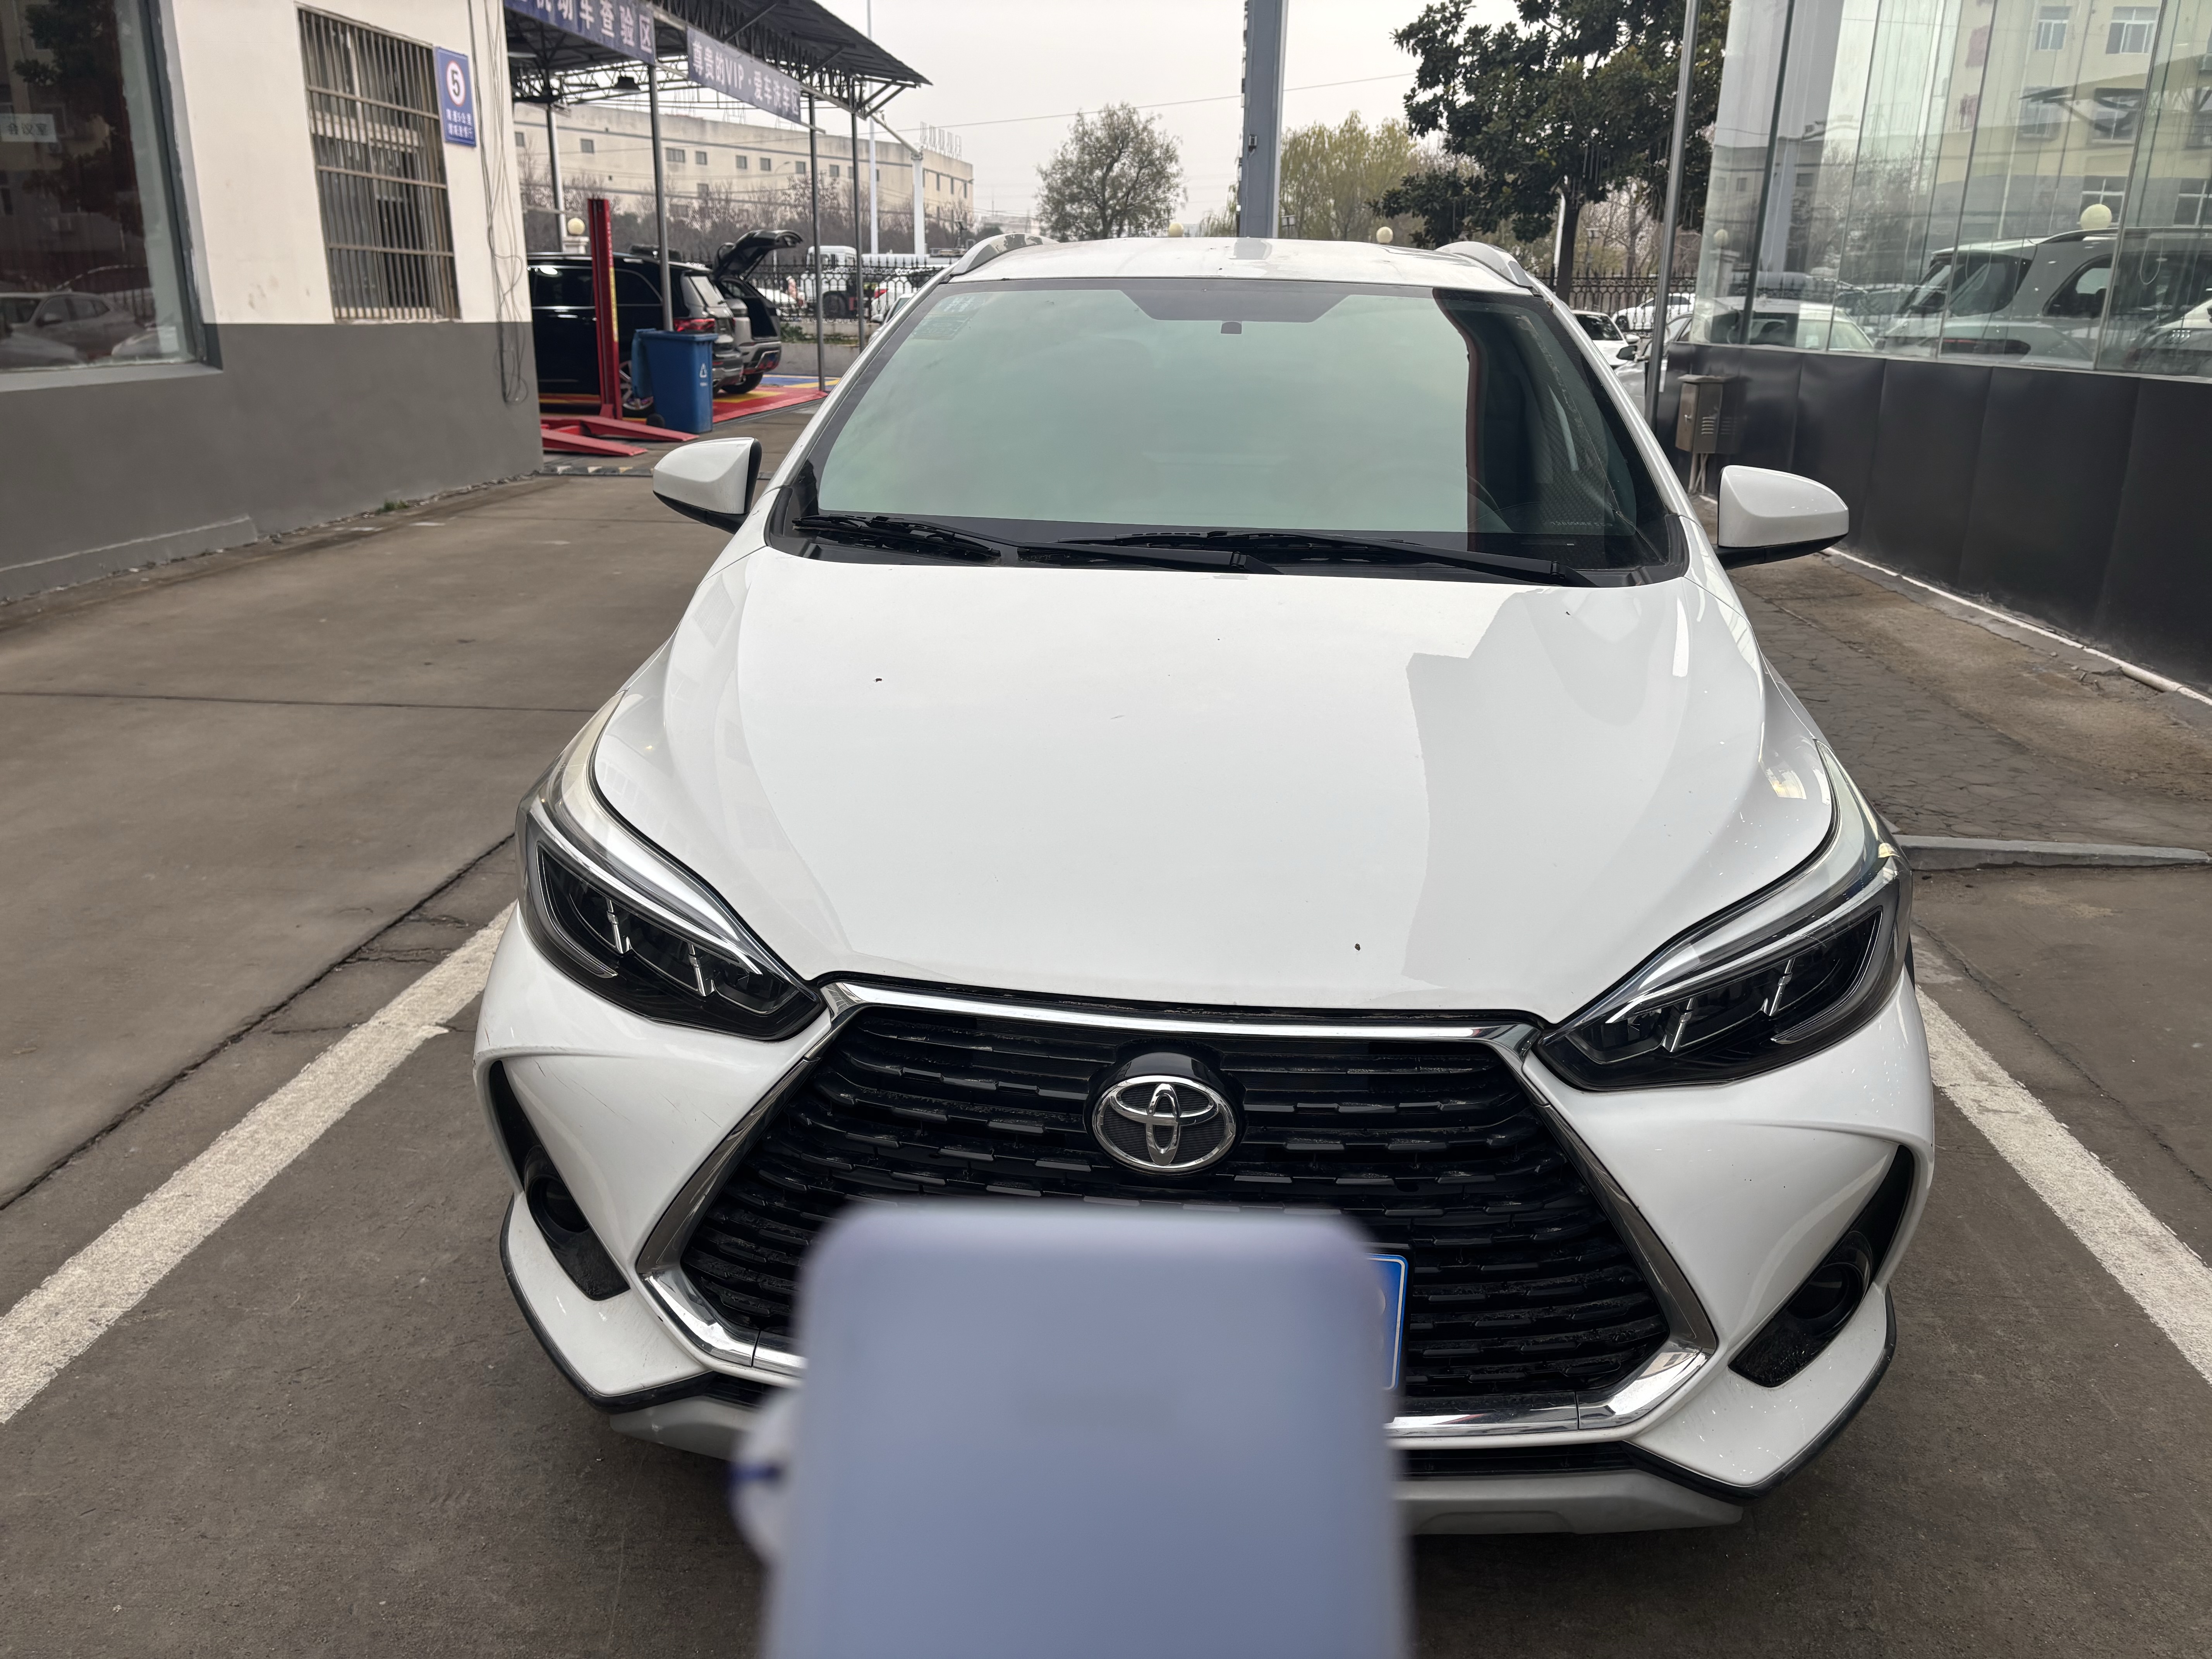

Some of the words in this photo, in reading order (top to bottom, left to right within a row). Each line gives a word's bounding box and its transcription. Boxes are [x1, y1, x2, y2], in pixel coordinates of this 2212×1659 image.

[522, 0, 653, 53] 动车查验区
[450, 69, 460, 96] 5
